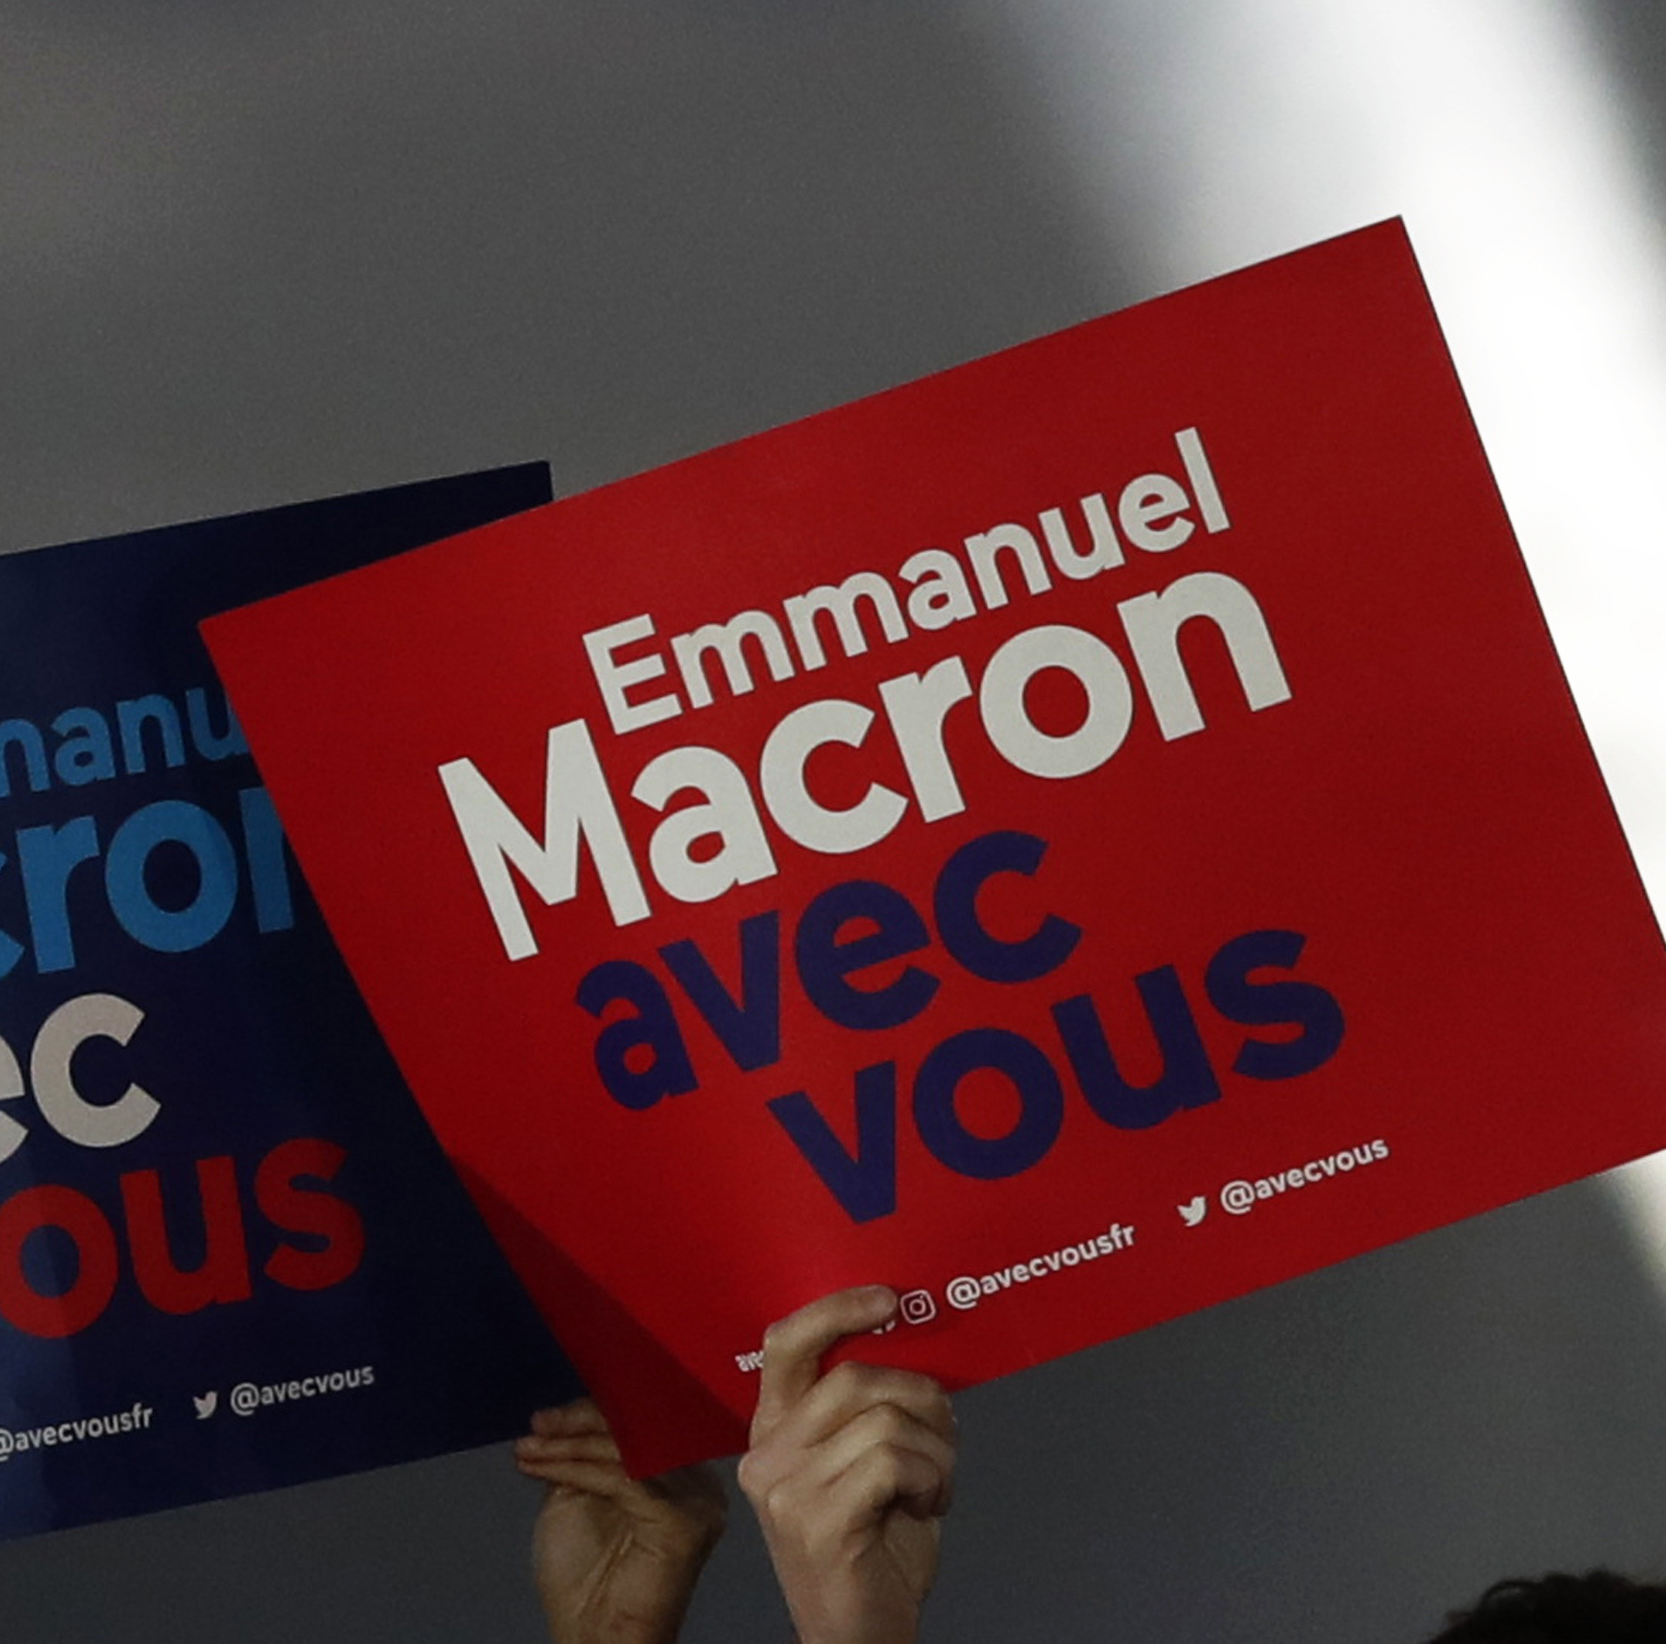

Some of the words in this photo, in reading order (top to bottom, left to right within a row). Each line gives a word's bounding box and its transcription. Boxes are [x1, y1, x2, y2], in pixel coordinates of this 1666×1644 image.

[582, 426, 1231, 735] Emmanuel
[437, 570, 1293, 962] Macron
[574, 829, 1084, 1112] avec
[767, 928, 1346, 1225] vous
[945, 1221, 1136, 1310] @avecvousfr
[1219, 1137, 1390, 1216] @avecvous
[229, 1365, 375, 1417] @avecvous
